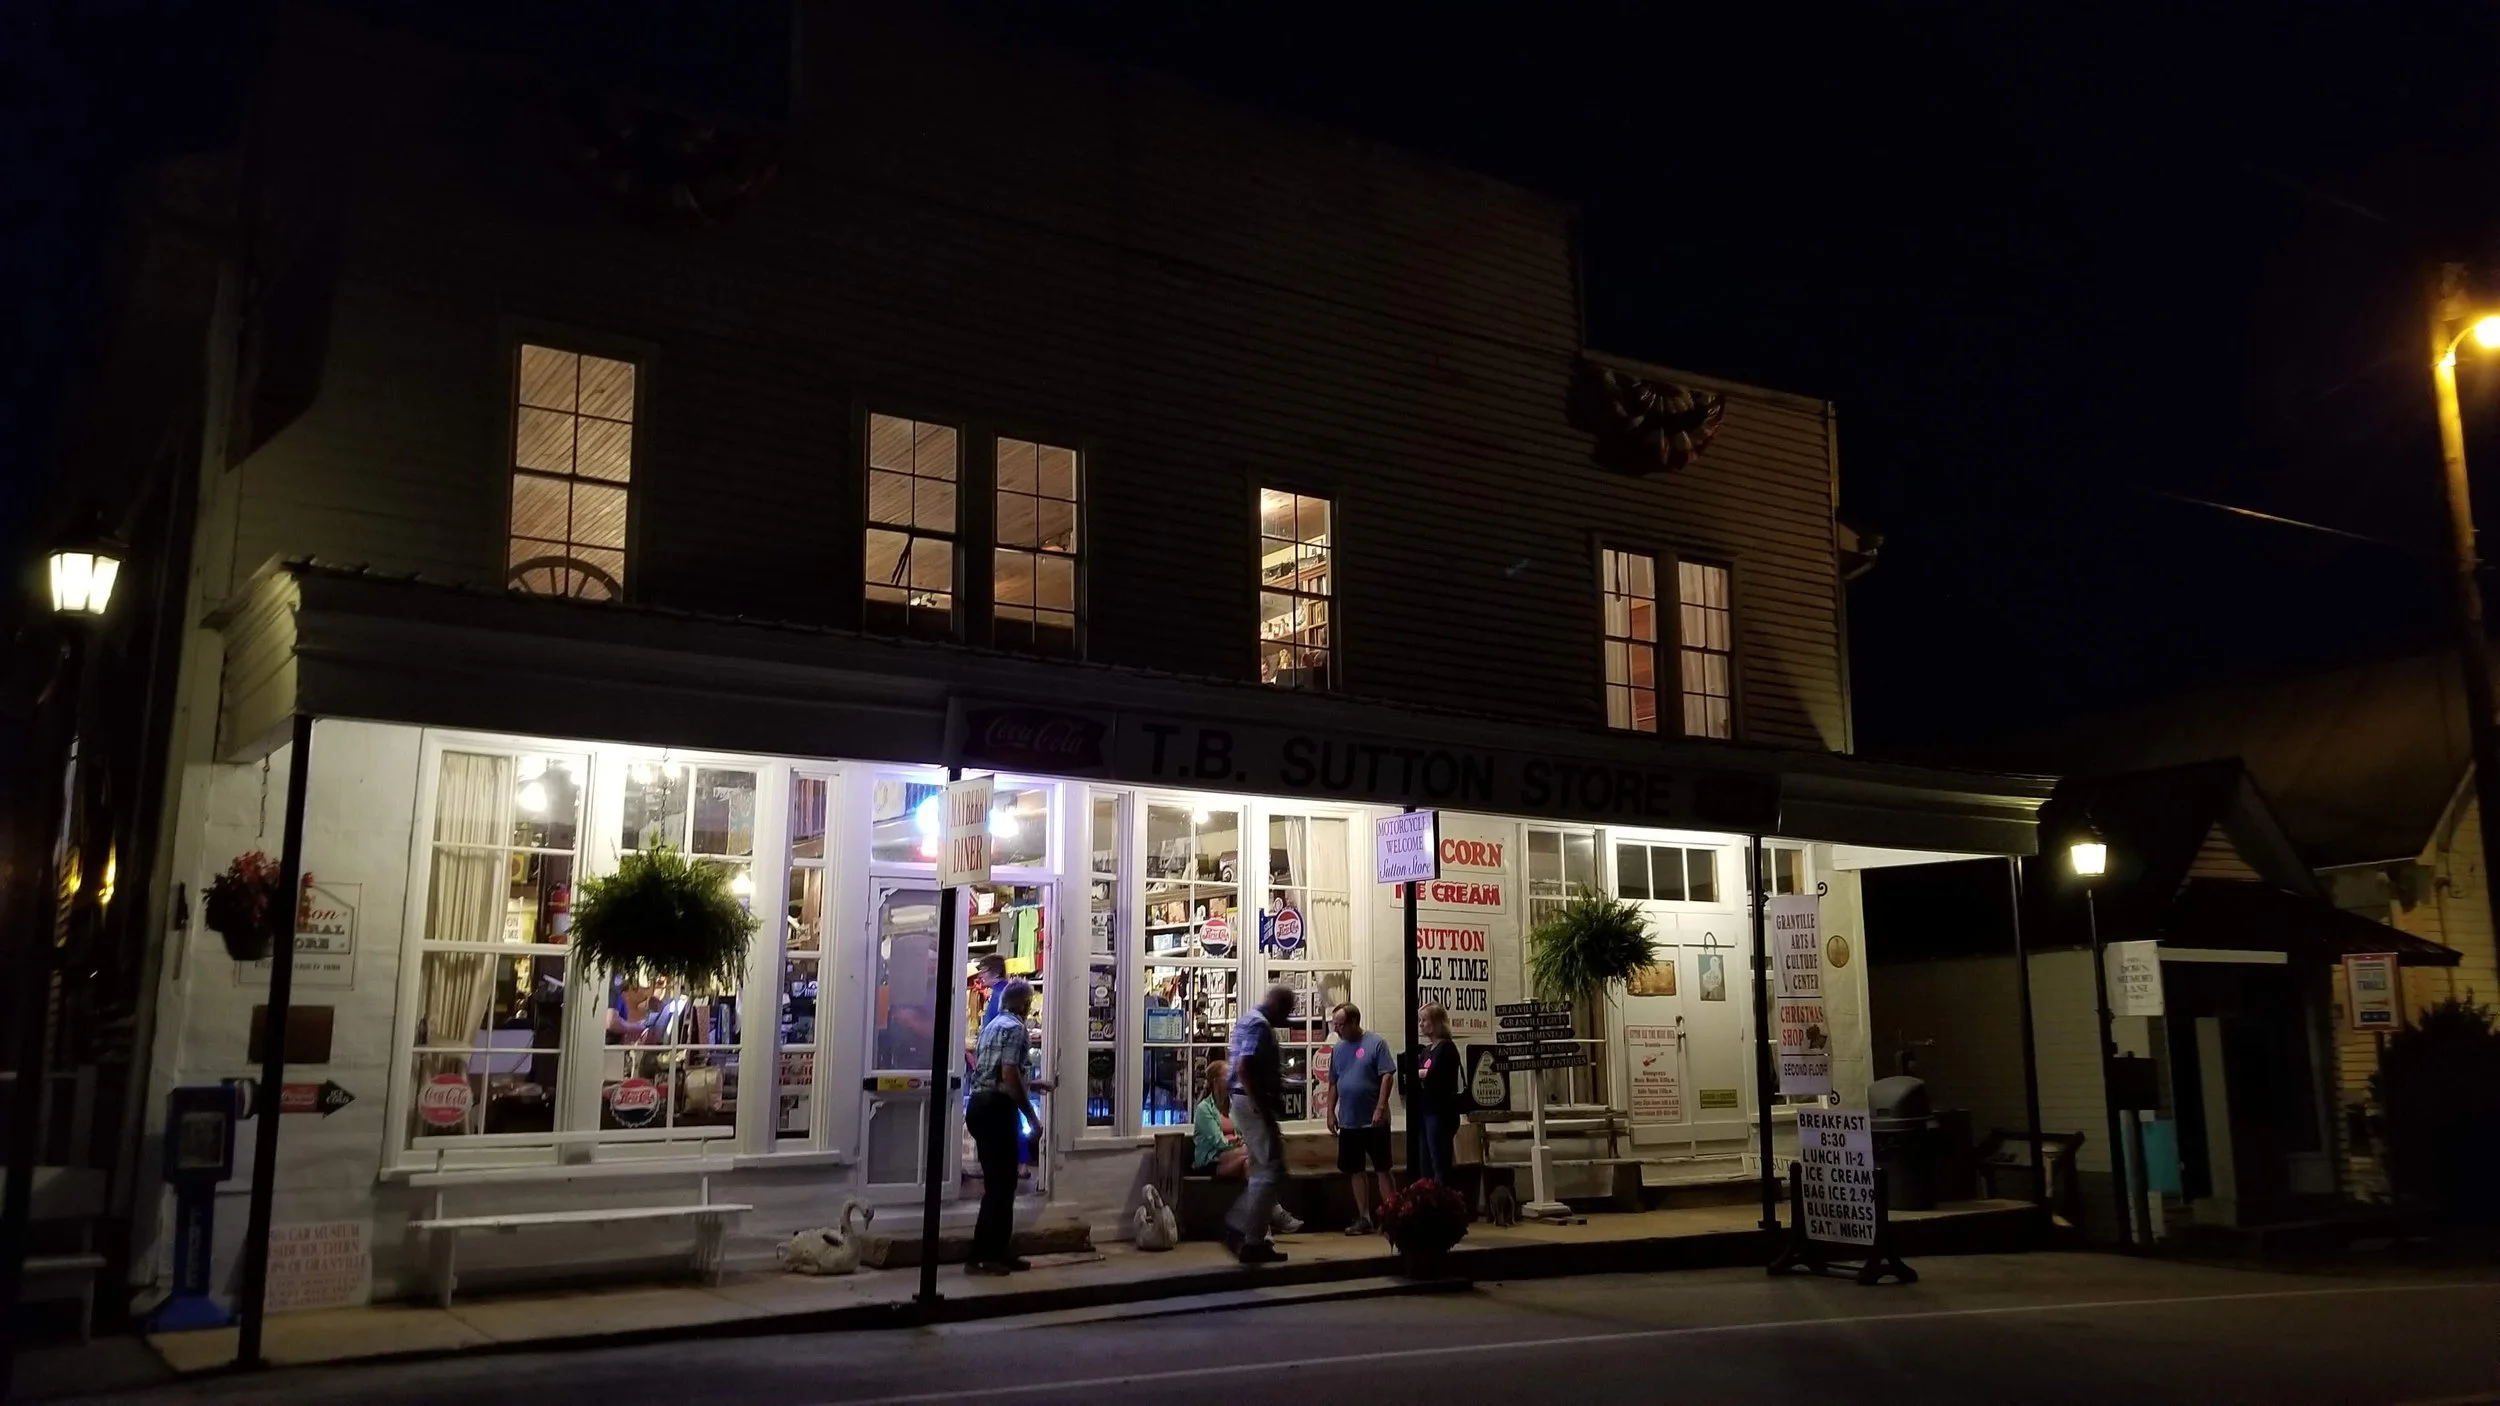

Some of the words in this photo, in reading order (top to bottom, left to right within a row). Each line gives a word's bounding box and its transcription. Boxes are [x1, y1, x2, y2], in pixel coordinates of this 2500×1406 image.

[1142, 724, 1246, 782] T.B.
[1280, 737, 1494, 801] SUTTON
[1520, 758, 1673, 817] STORE
[951, 787, 990, 828] MAYBERRY
[1386, 836, 1423, 854] WELCOME
[1441, 839, 1503, 867] CORN
[953, 835, 983, 873] DINER
[1380, 859, 1406, 878] Sutton
[1409, 855, 1431, 875] Store
[1396, 881, 1426, 901] IE
[1432, 881, 1501, 905] CREAM
[1776, 914, 1815, 930] GRANVILLE
[1791, 934, 1808, 949] ARTS
[1448, 958, 1489, 982] TIME
[1786, 954, 1817, 969] CULTURE
[1793, 974, 1819, 989] CENTER
[1456, 988, 1488, 1011] HOUR
[1497, 1003, 1539, 1014] GRANVILLE
[1781, 1006, 1823, 1023] CHRISTMAS
[1504, 1017, 1545, 1028] GRANVILLE
[1498, 1032, 1525, 1042] SUTTON
[1527, 1030, 1570, 1041] HOMESTEAD
[1783, 1029, 1803, 1046] SHOP
[1497, 1062, 1510, 1071] THE
[1784, 1063, 1807, 1076] SECOND
[1809, 1063, 1828, 1076] FLOOR
[1282, 1093, 1302, 1115] EN
[1800, 1114, 1864, 1130] BREAKFAST
[1821, 1132, 1846, 1147] 8:30
[1803, 1149, 1840, 1165] LUNCH
[1805, 1166, 1823, 1181] ICE
[1831, 1168, 1871, 1185] CREAM
[1803, 1184, 1825, 1199] BAG
[1828, 1186, 1846, 1201] ICE
[1850, 1187, 1876, 1203] 2.99
[1807, 1202, 1873, 1221] BLUEGRASS
[1811, 1220, 1836, 1236] SAT.
[1840, 1223, 1873, 1239] NIGHT
